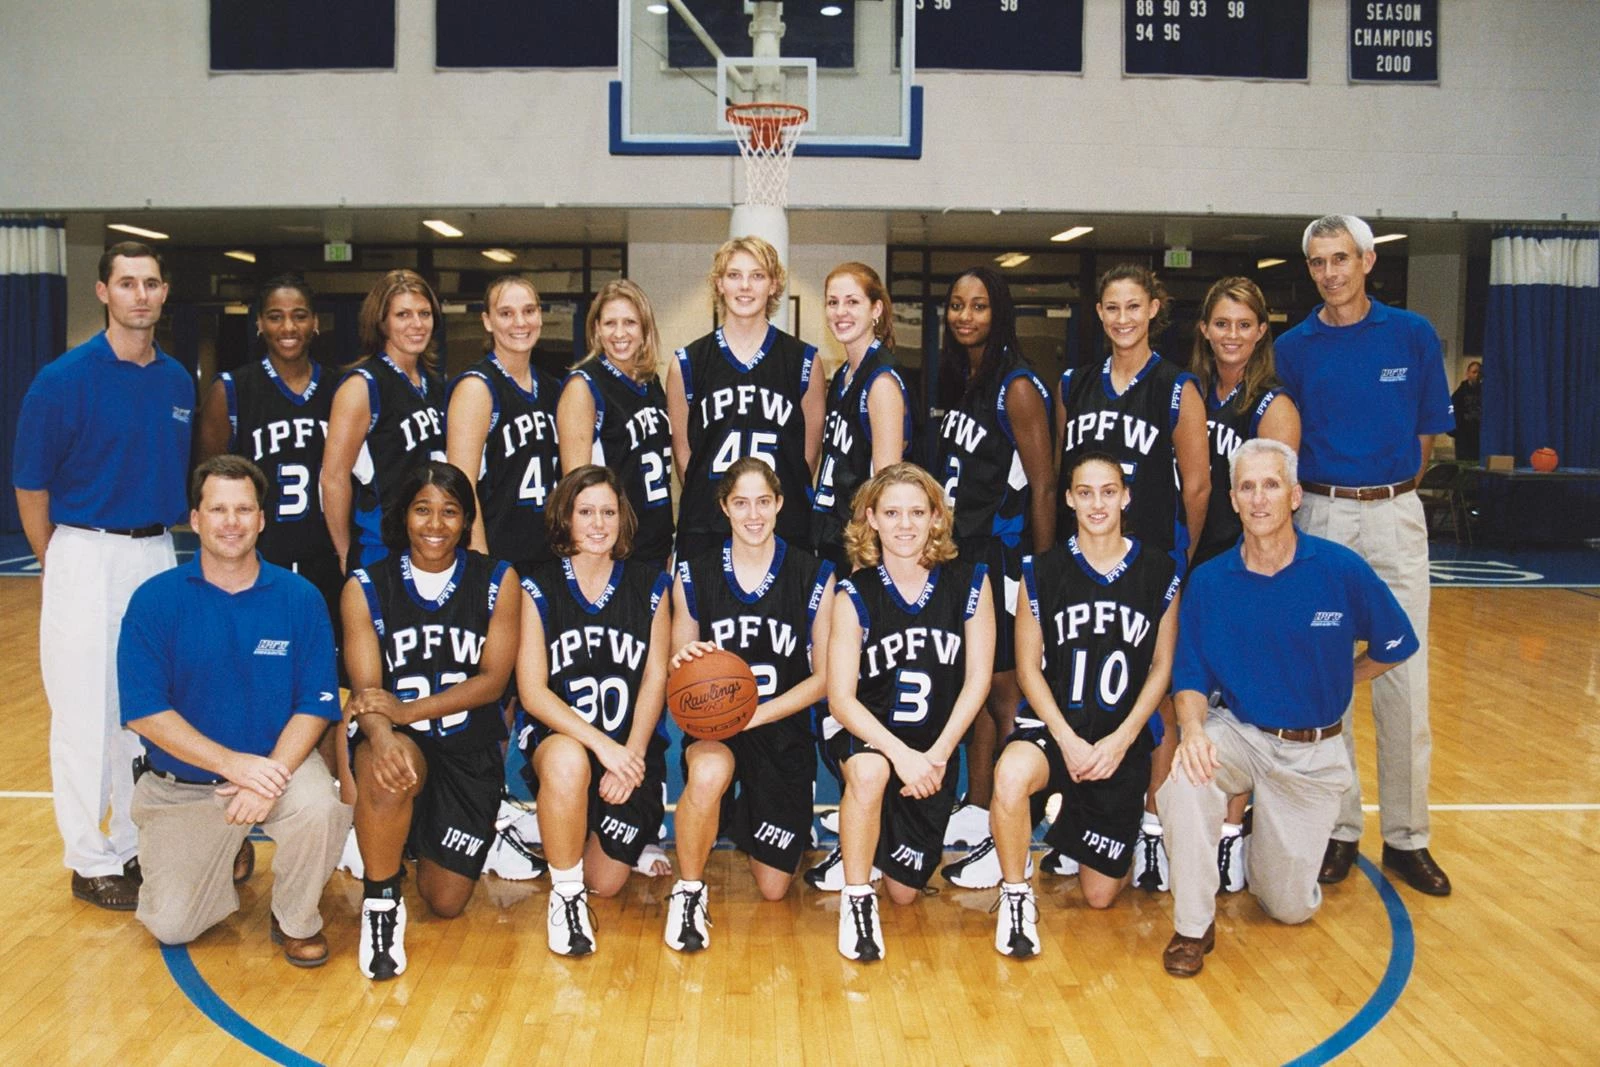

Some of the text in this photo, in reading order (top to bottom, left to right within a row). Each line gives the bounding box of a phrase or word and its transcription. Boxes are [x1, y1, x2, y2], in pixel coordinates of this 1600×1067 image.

[1164, 0, 1180, 16] 90
[1190, 0, 1207, 17] 93
[1228, 1, 1245, 18] 98
[1366, 3, 1421, 21] SEASON
[1136, 24, 1180, 41] 94 96
[1355, 28, 1432, 47] CHAMPIONS
[1376, 54, 1411, 73] 2000
[801, 358, 812, 382] IPFW
[701, 384, 793, 429] IPFW
[997, 385, 1006, 410] IPFW
[1171, 383, 1182, 409] IPFW
[1256, 391, 1274, 416] IPFW
[252, 417, 328, 461] IPF
[400, 407, 445, 451] IPF
[1066, 410, 1159, 455] IPFW
[711, 431, 778, 473] 45
[518, 456, 559, 507] 4
[400, 555, 413, 580] IPFW
[723, 548, 733, 572] IPFW
[1105, 560, 1128, 583] IPFW
[436, 581, 457, 607] IPFW
[594, 584, 616, 610] IPFW
[755, 572, 775, 598] IPFW
[808, 583, 824, 610] IPFW
[917, 582, 934, 608] IPFW
[1165, 575, 1181, 601] IPFW
[966, 587, 980, 614] IPFW
[711, 615, 798, 657] PFW
[1054, 600, 1150, 648] IPFW
[550, 626, 646, 676] IPFW
[867, 628, 961, 678] IPFW
[1071, 649, 1129, 706] 10
[567, 676, 629, 732] 30
[680, 681, 741, 713] Rawlings
[891, 670, 933, 724] 3
[441, 827, 484, 857] IPFW
[600, 815, 639, 845] IPFW
[754, 822, 795, 850] IPFW
[890, 844, 924, 871] IPFW
[1082, 830, 1125, 860] IPFW
